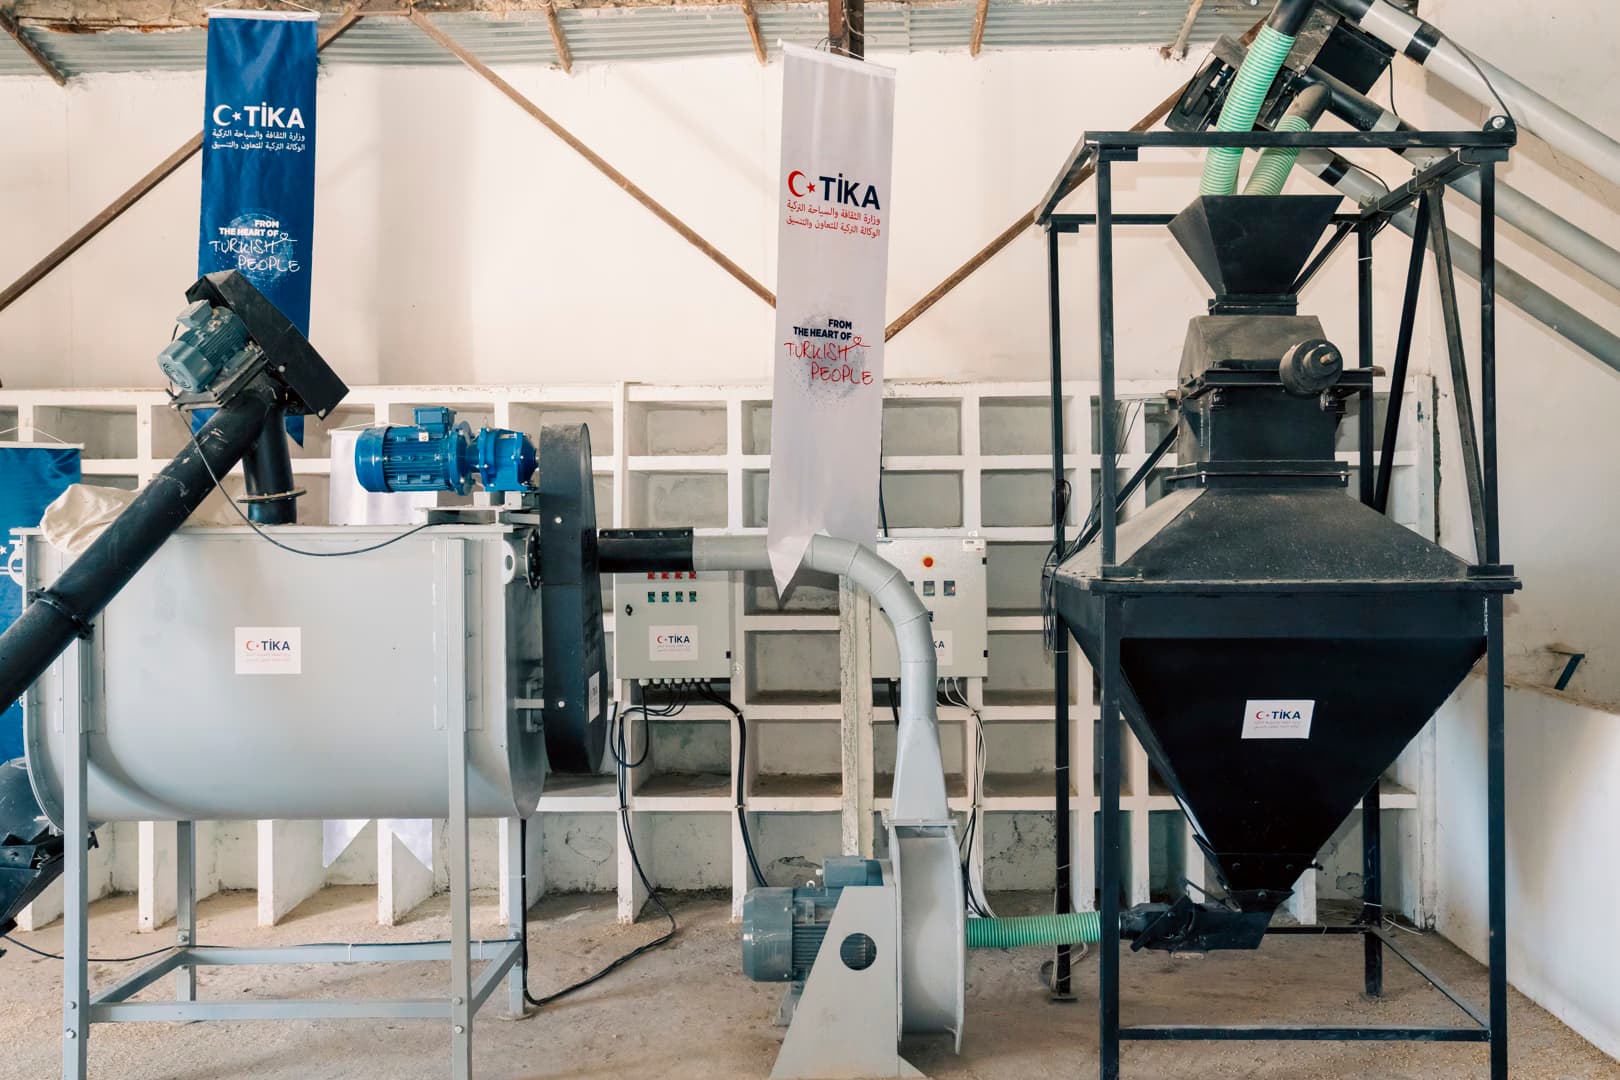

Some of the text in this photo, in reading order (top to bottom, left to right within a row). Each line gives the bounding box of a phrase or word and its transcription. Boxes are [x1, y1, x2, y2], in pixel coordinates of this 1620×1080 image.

[243, 102, 305, 128] TİKA
[289, 132, 305, 141] وزارة
[819, 173, 880, 210] TİKA
[787, 199, 805, 212] التركية
[254, 220, 279, 228] FROM
[864, 213, 880, 225] وزارة
[218, 227, 279, 237] THE HEART OF
[208, 237, 277, 254] TURKISH
[238, 254, 300, 272] PEOPLE
[828, 319, 852, 330] FROM
[793, 326, 852, 341] THE HEART OF
[784, 340, 850, 362] TURKISH
[811, 361, 873, 385] PEOPLE
[261, 638, 290, 651] TİKA
[667, 634, 690, 644] TİKA
[1271, 709, 1301, 720] TİKA
